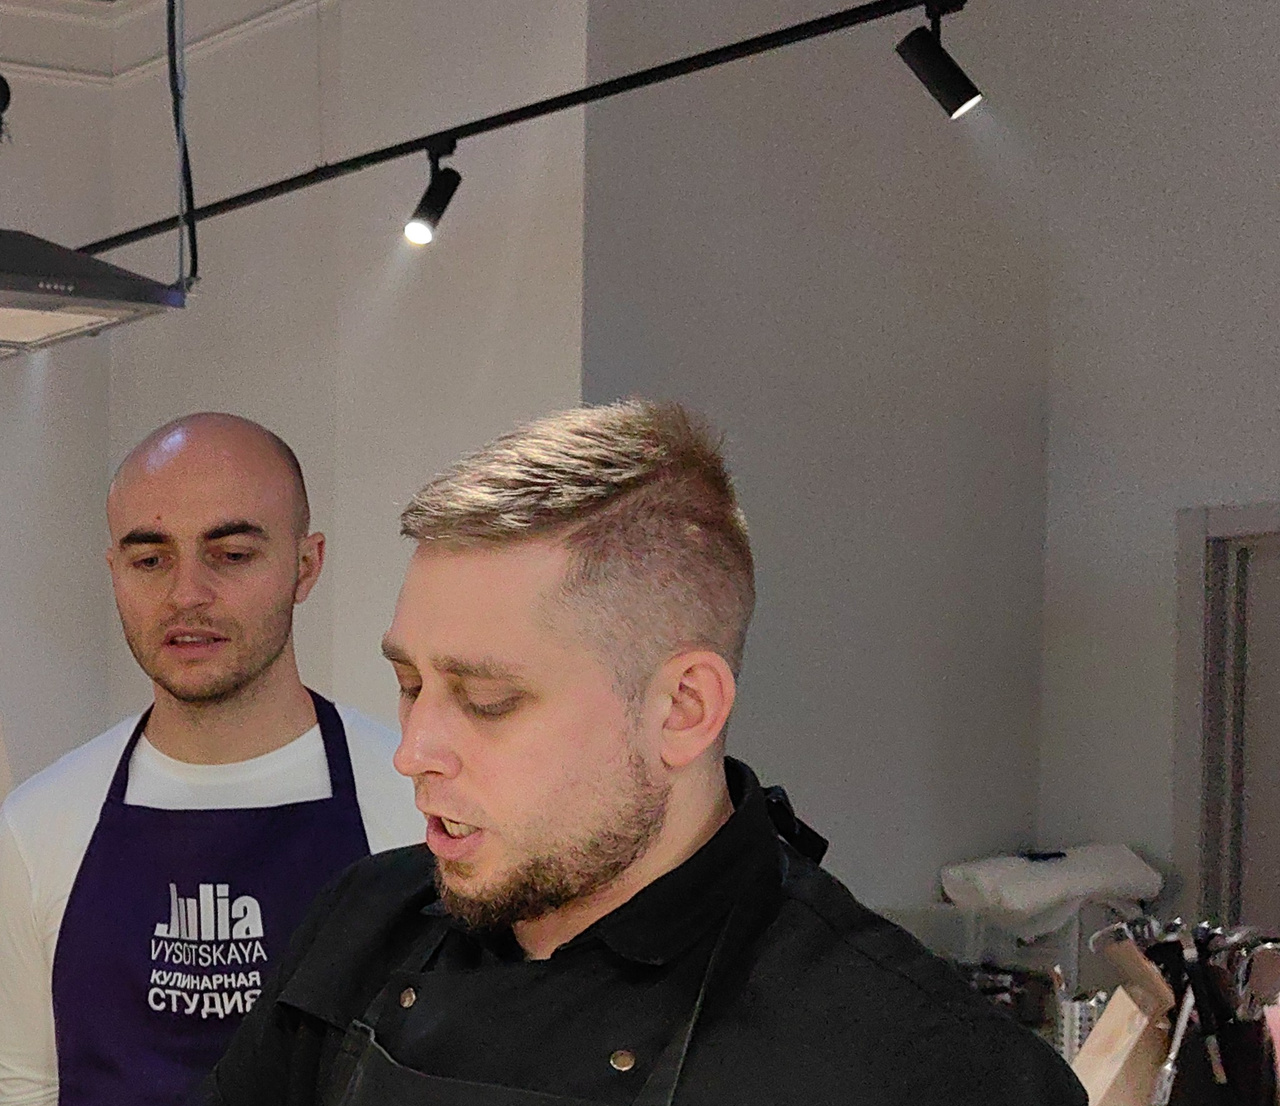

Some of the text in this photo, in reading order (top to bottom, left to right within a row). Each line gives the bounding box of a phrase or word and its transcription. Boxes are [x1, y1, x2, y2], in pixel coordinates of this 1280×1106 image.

[154, 882, 264, 941] Julia
[151, 939, 268, 967] VYSOTSKAYA
[150, 969, 261, 991] КУЛИНАРНАЯ
[148, 987, 262, 1019] СТУДИЯ
